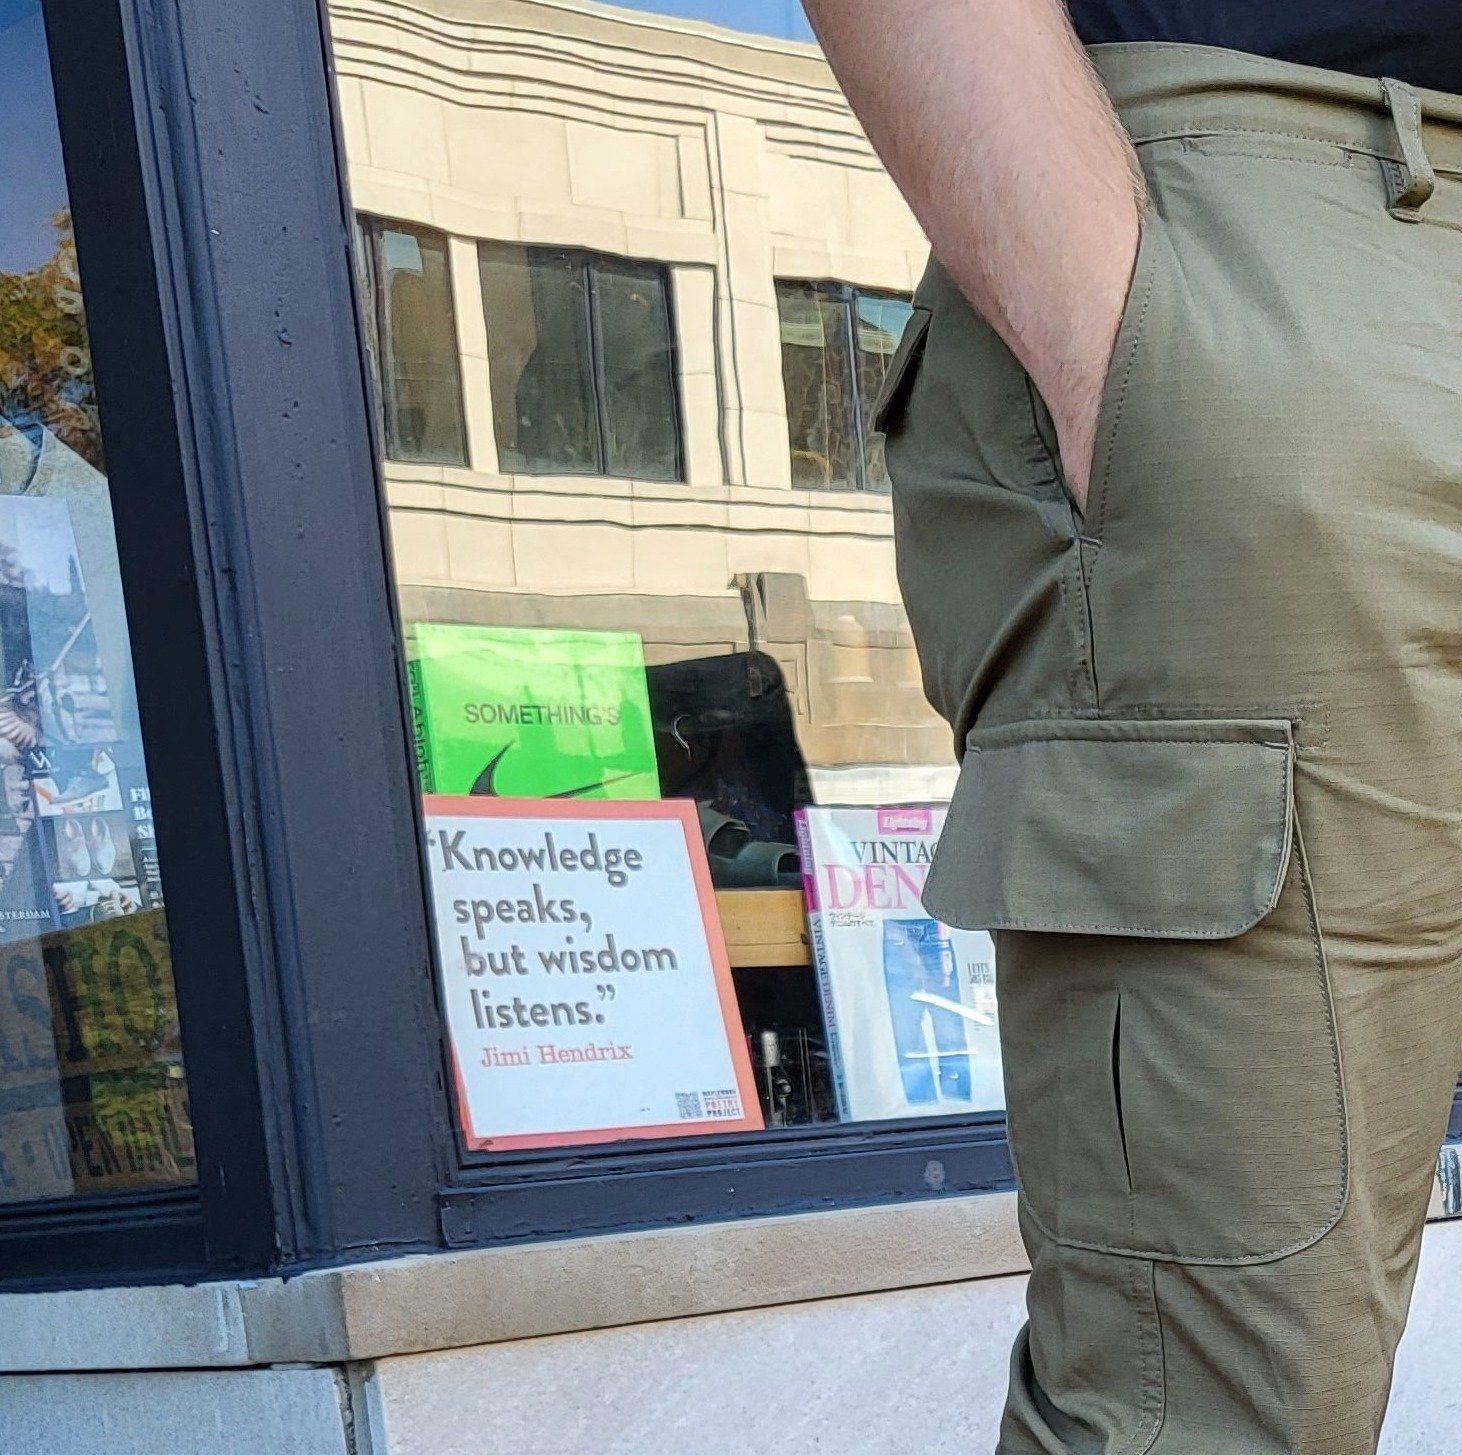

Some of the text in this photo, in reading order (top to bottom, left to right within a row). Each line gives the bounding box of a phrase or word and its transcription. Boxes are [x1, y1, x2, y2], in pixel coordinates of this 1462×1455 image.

[464, 702, 620, 727] SOMETHING'S
[452, 883, 594, 941] speaks,
[459, 932, 679, 977] but wisdom
[469, 983, 617, 1030] listens.”
[480, 1040, 635, 1068] Jimi Hendrix
